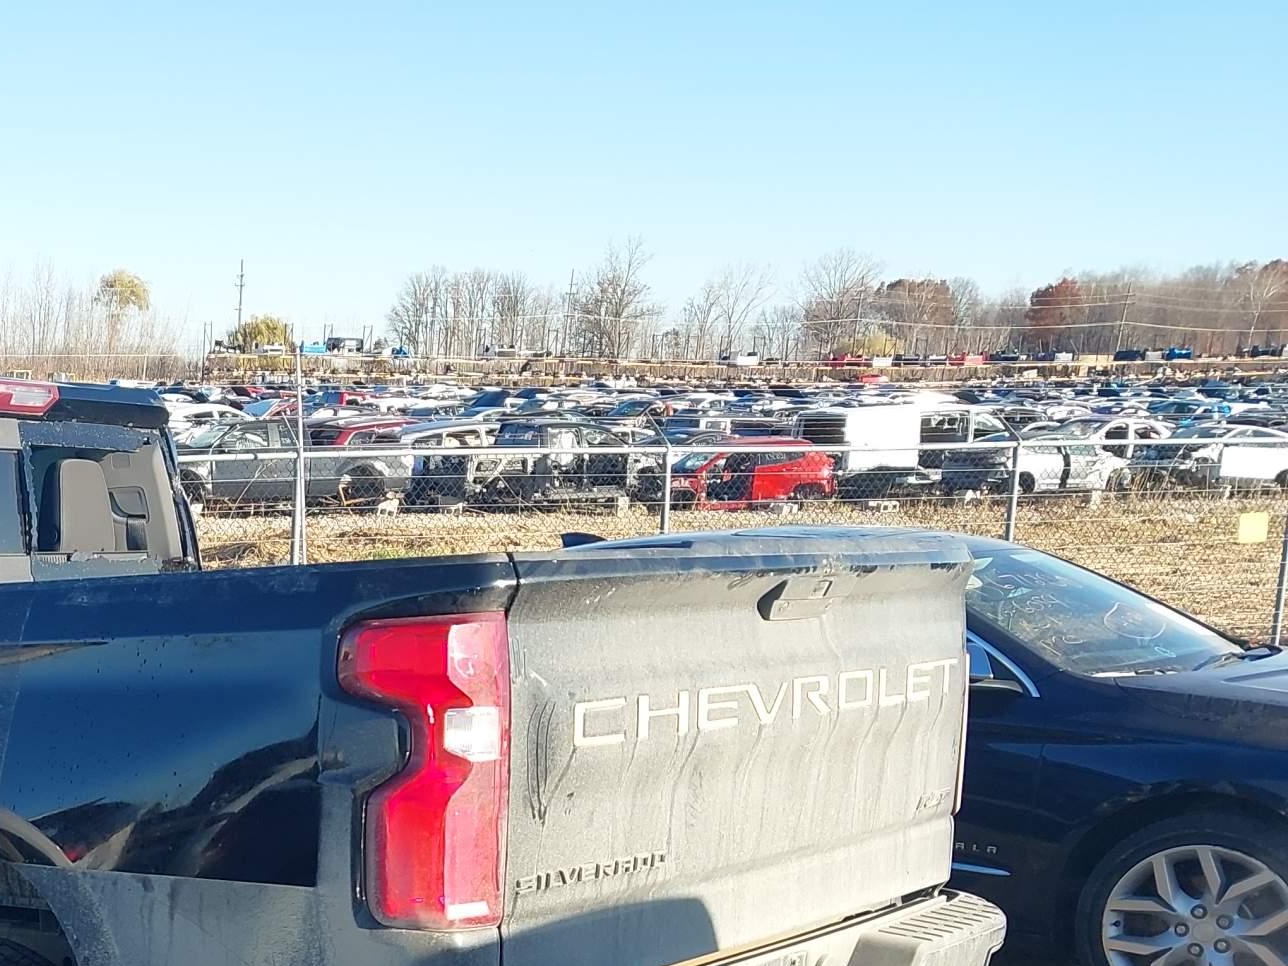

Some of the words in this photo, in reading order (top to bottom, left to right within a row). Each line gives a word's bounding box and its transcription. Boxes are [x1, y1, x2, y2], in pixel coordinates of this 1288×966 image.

[573, 658, 958, 747] CHEVROLET
[955, 842, 997, 854] ALA
[515, 849, 665, 895] SILVERADO
